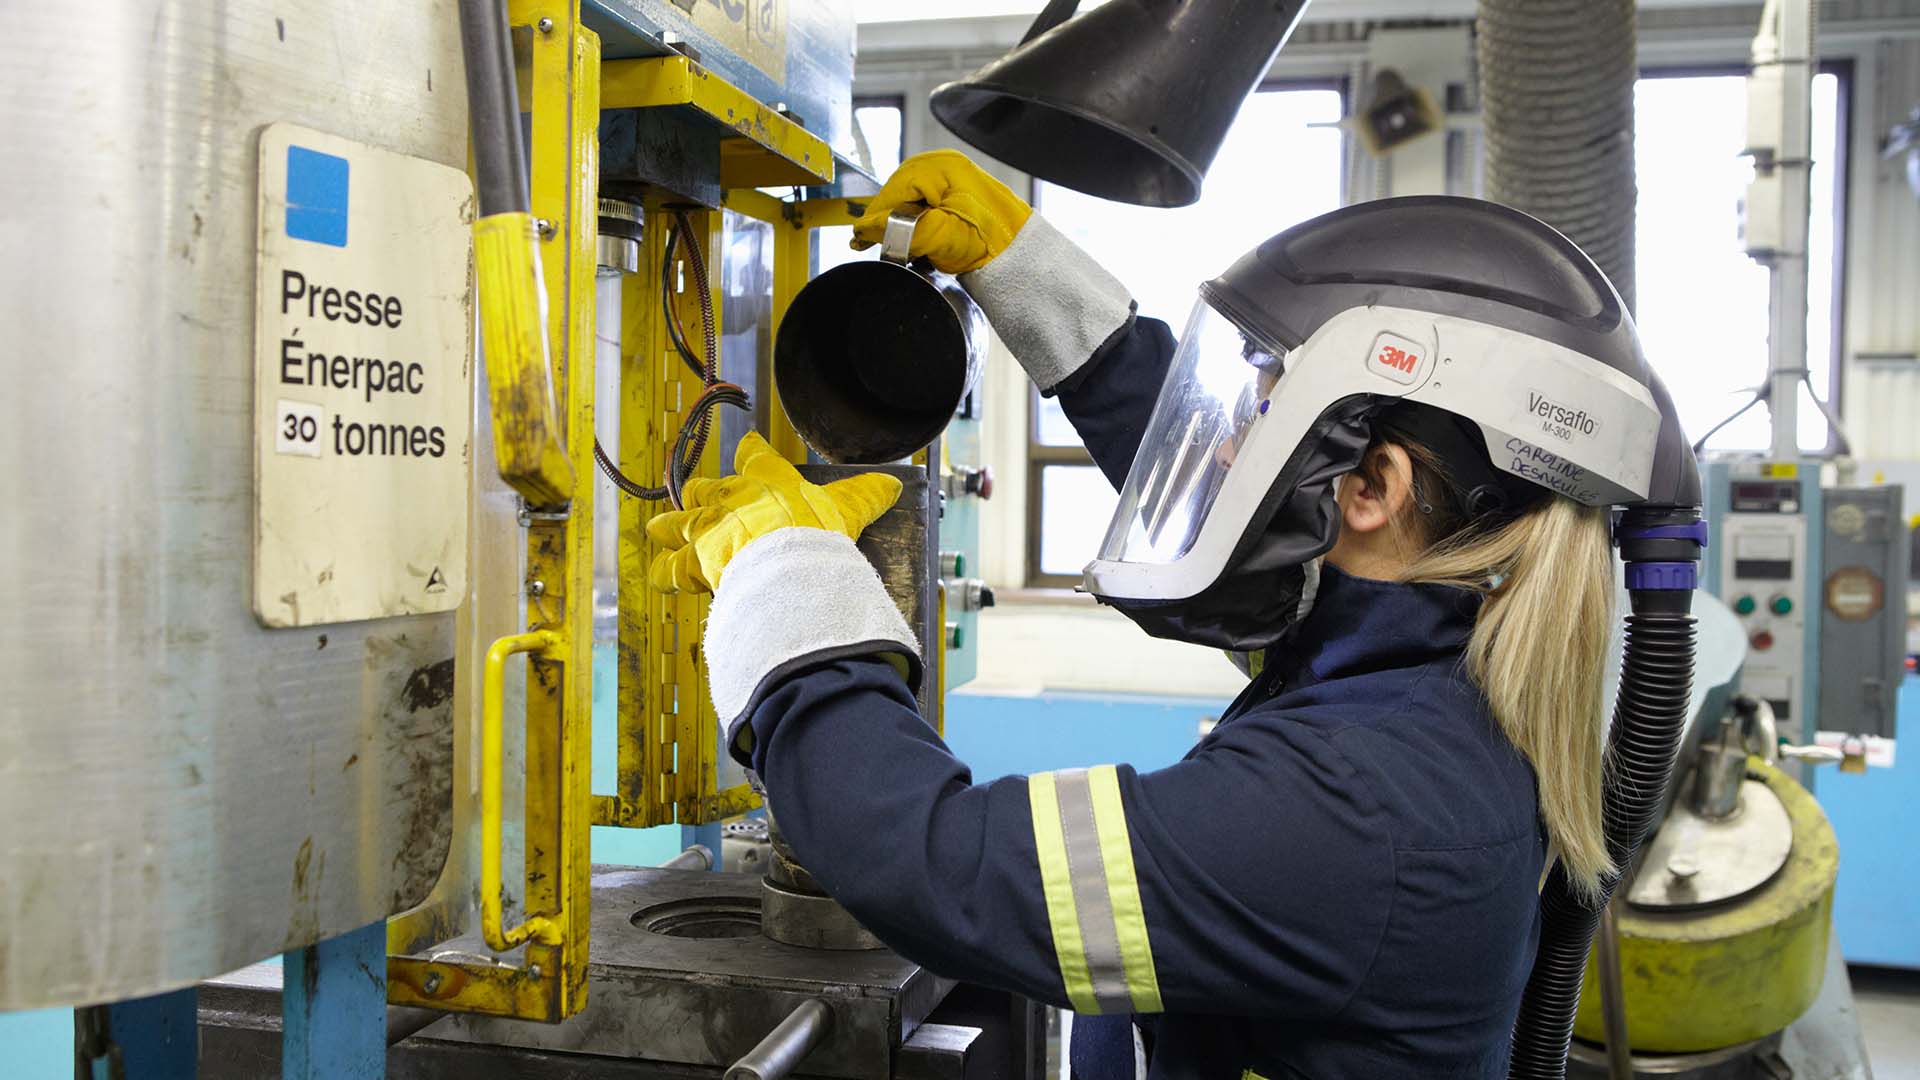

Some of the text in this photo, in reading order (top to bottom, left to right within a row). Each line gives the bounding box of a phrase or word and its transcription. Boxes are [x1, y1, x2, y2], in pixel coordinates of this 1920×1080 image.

[282, 269, 402, 329] Presse
[281, 328, 424, 402] Énerpac
[1378, 345, 1418, 374] 3M
[1529, 391, 1595, 435] Versaflo
[1542, 421, 1571, 441] M-300
[284, 413, 446, 458] 30 tonnes
[1505, 438, 1585, 481] CAROLINE
